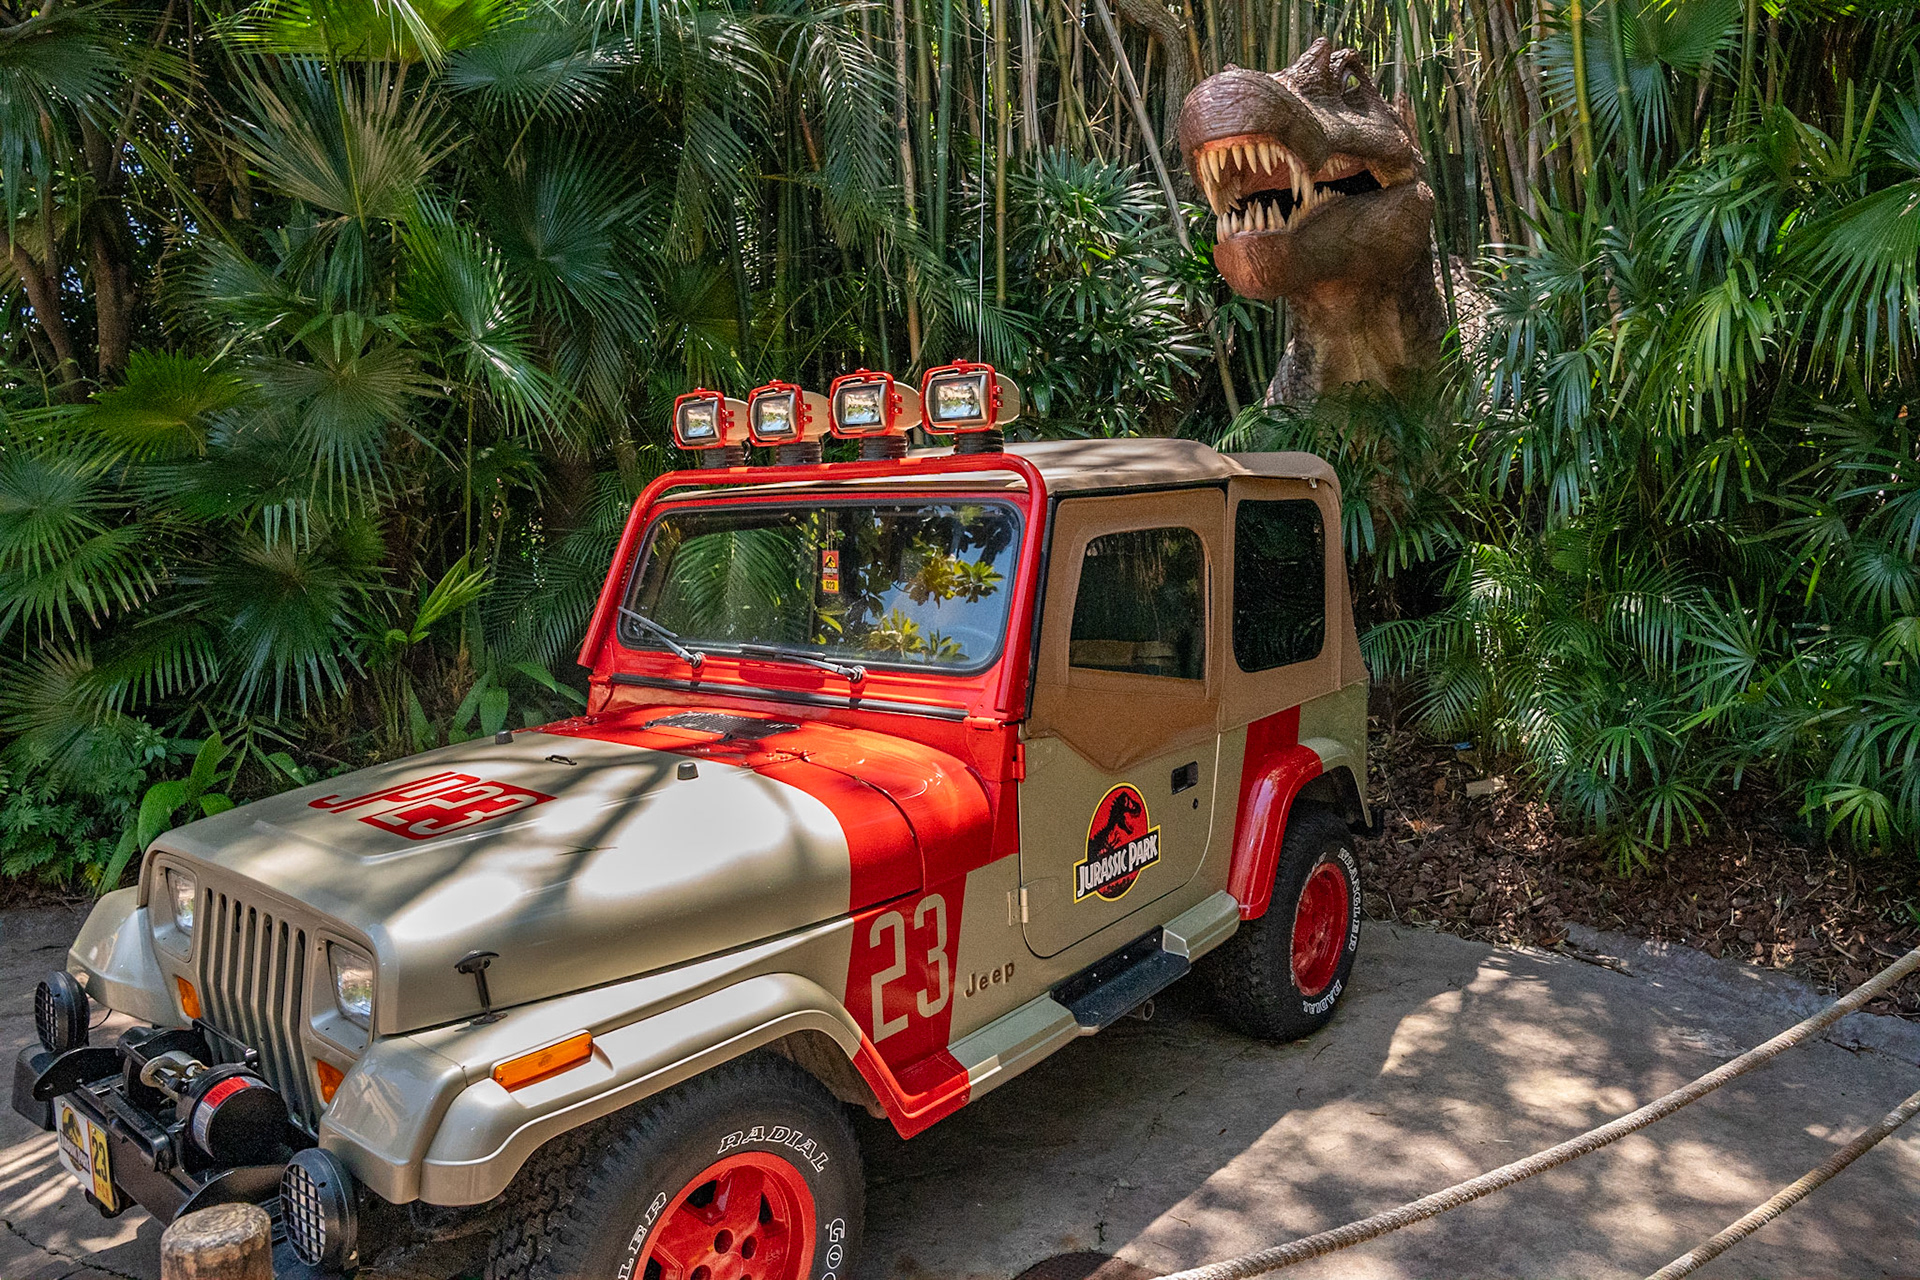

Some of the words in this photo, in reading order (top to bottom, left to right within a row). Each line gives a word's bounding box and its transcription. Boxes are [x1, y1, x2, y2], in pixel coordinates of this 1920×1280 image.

[371, 785, 538, 836] 23
[1077, 848, 1128, 898] JURASSIC
[1128, 834, 1158, 872] PARK
[1337, 847, 1361, 952] WRANGLER
[869, 893, 950, 1044] 23
[964, 960, 1015, 999] Jeep
[1302, 979, 1343, 1014] RADIAL
[92, 1135, 108, 1183] 23
[717, 1125, 830, 1173] RADIAL
